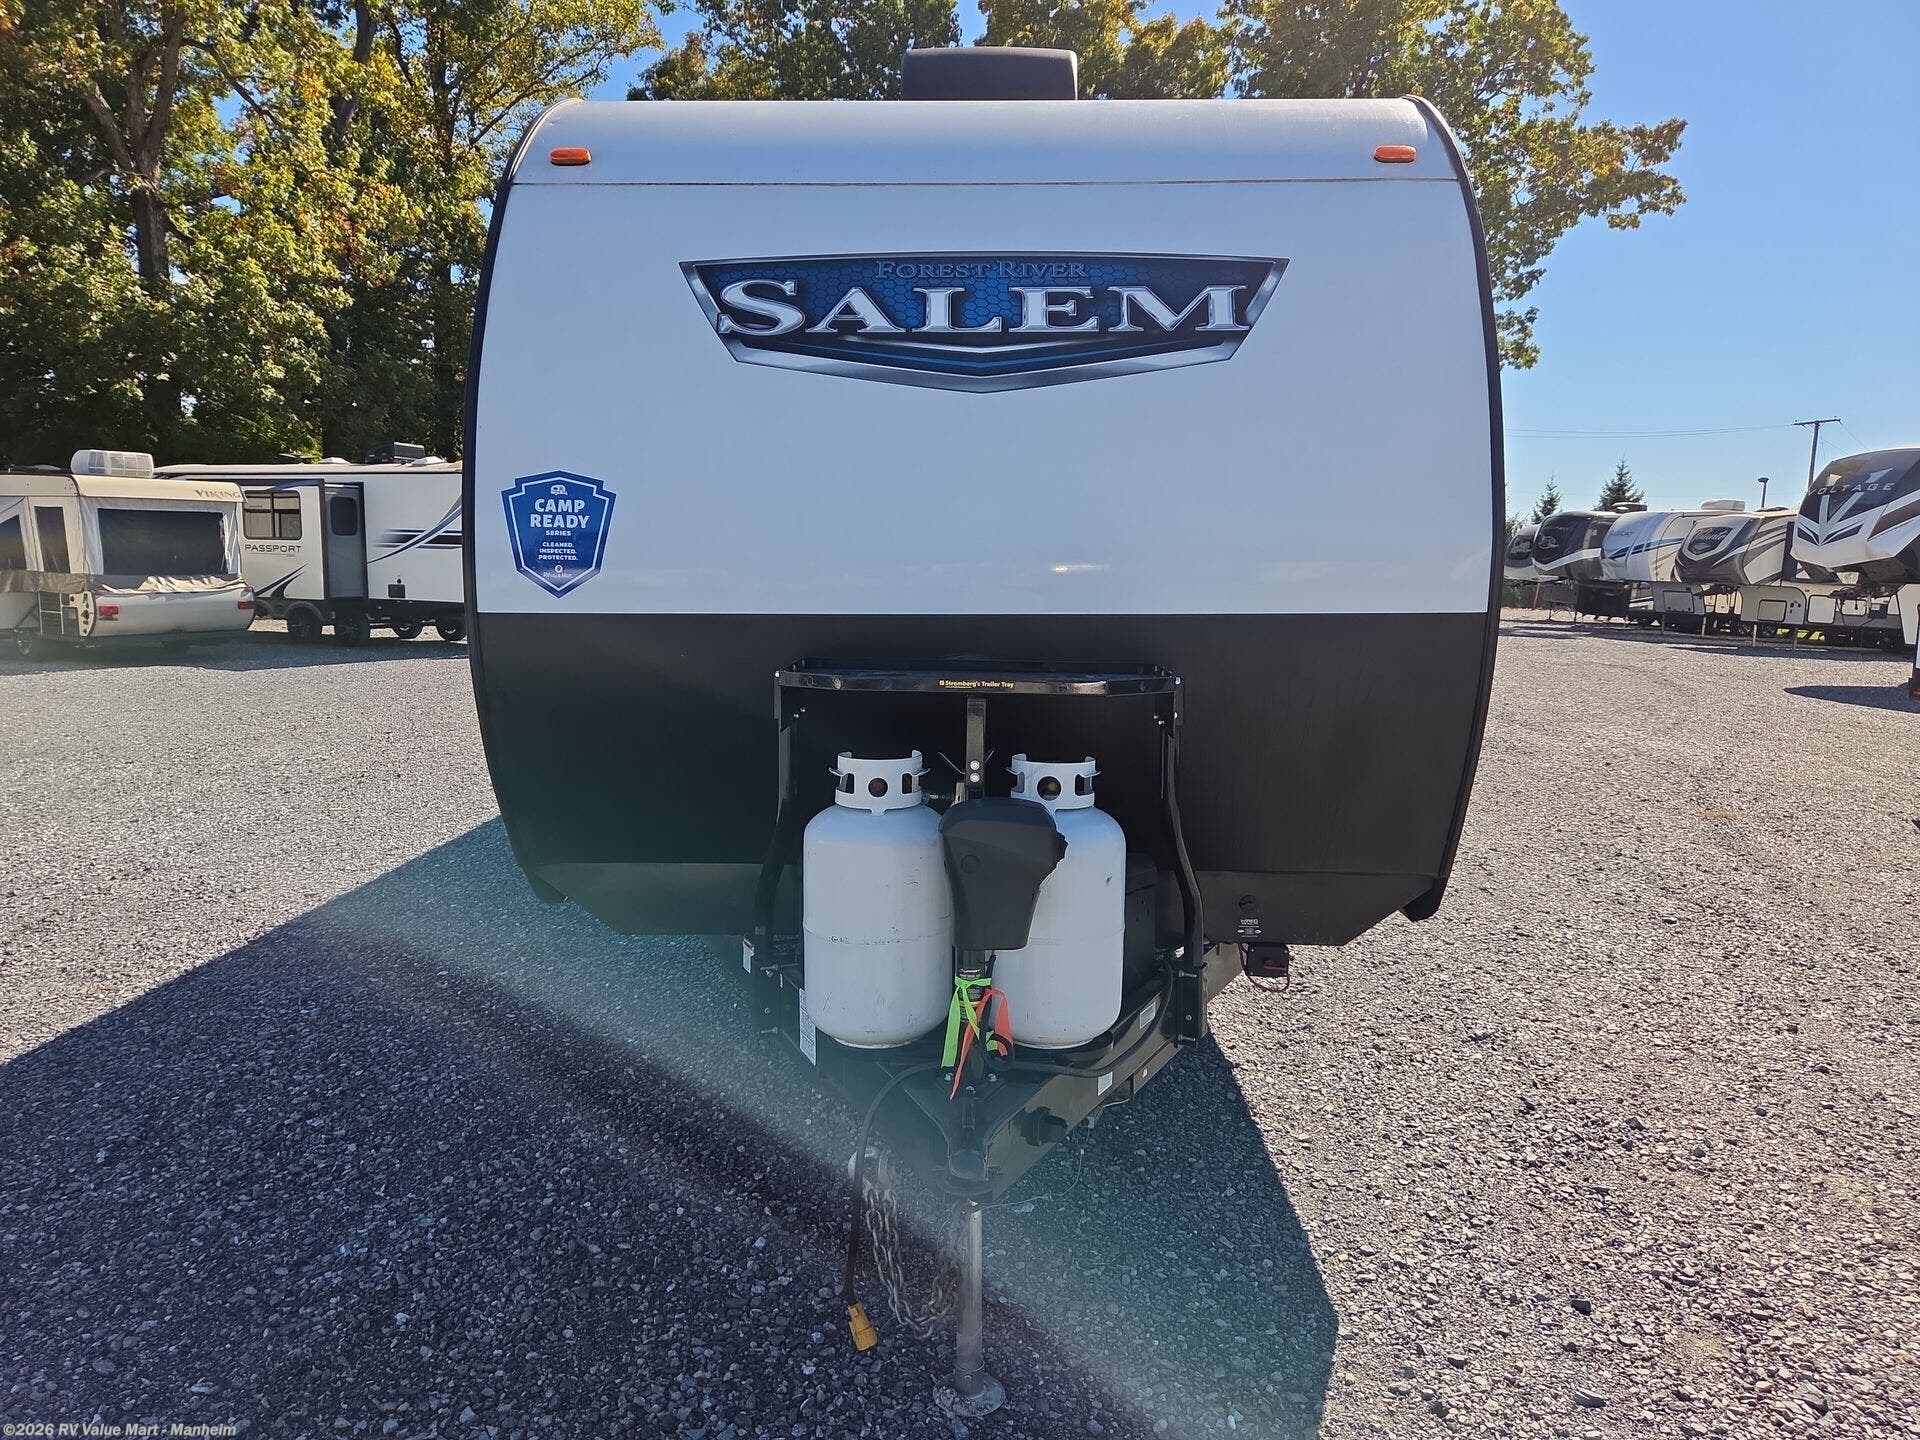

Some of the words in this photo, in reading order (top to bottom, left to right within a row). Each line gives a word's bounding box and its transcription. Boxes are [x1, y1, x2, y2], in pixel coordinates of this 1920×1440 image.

[876, 260, 991, 280] FOREST
[995, 260, 1088, 279] RIVER
[716, 279, 1252, 337] SALEM
[195, 489, 241, 499] VIKING
[1807, 482, 1895, 496] VOLTAGE
[534, 498, 586, 513] CAMP
[529, 514, 590, 529] READY
[245, 544, 302, 553] PASSPORT
[1001, 681, 1015, 689] Tray
